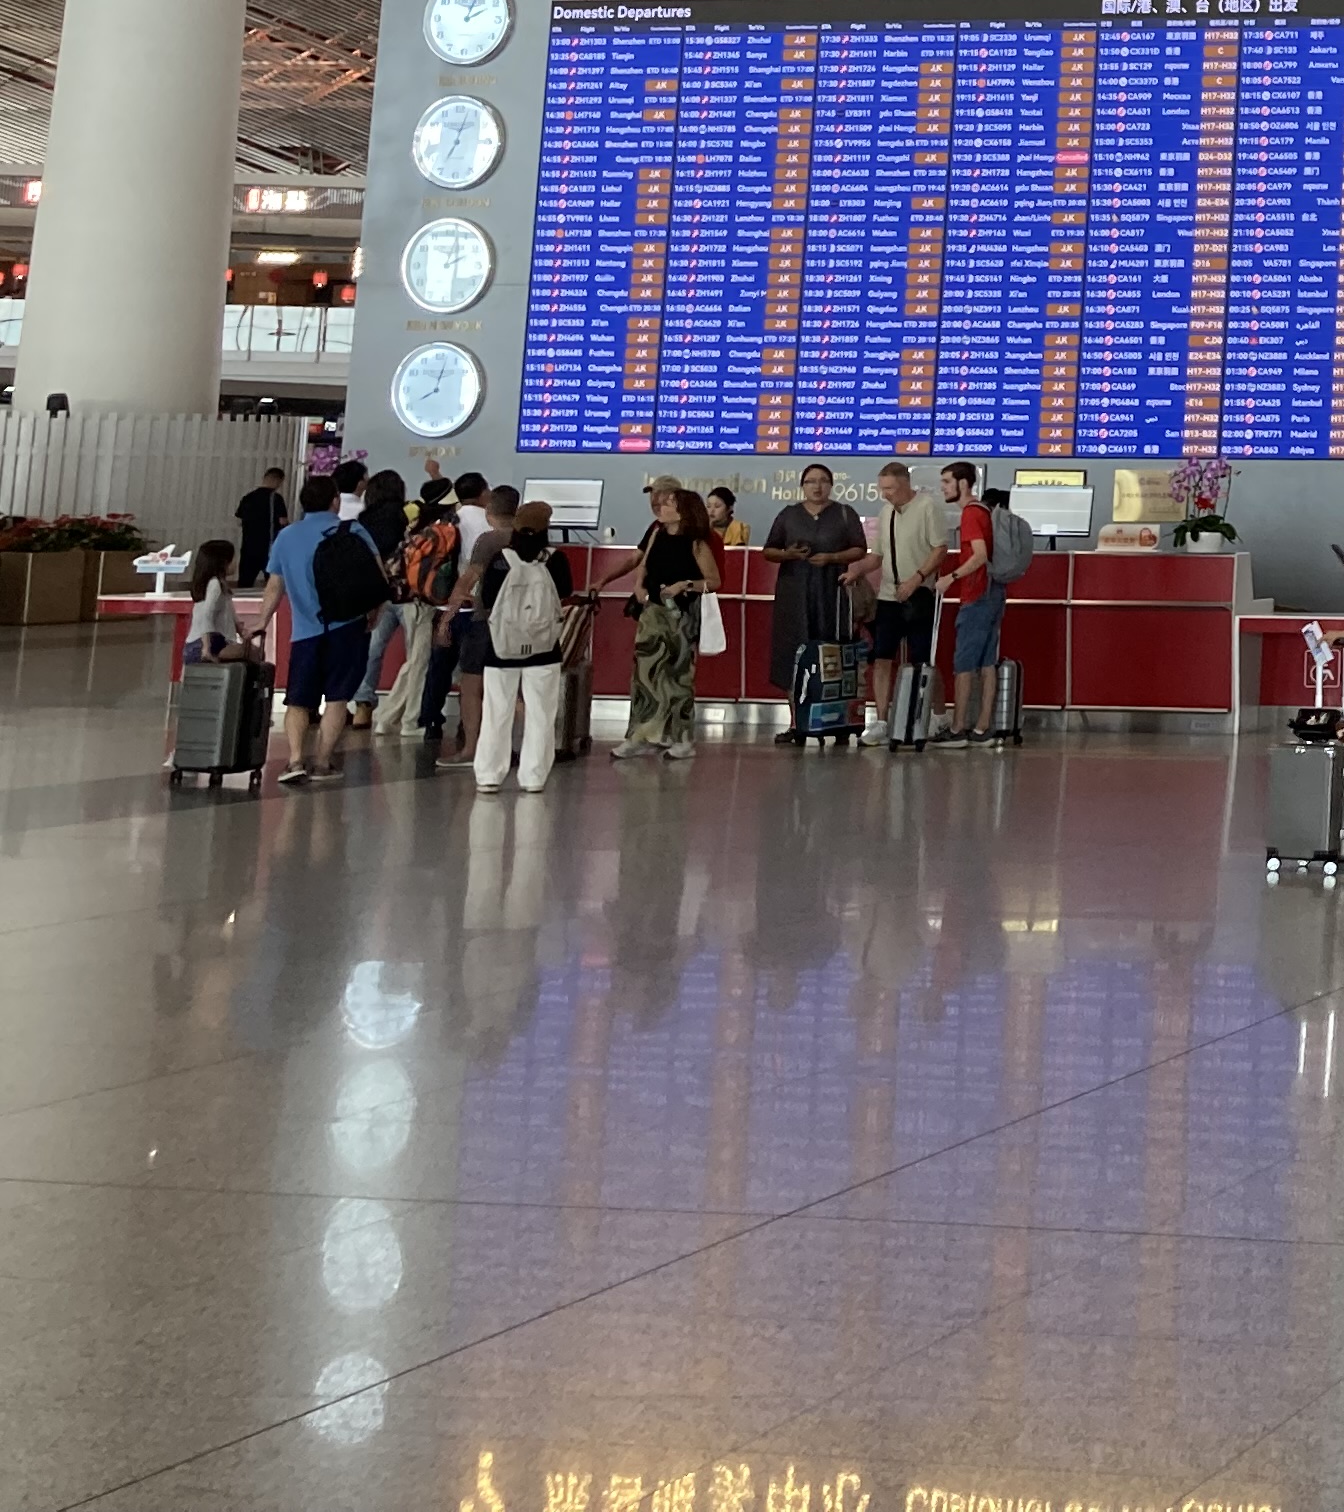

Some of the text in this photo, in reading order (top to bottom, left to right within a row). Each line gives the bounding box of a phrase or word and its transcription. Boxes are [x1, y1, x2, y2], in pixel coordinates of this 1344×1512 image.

[553, 5, 691, 21] Domestic Departures
[833, 483, 886, 502] 9615
